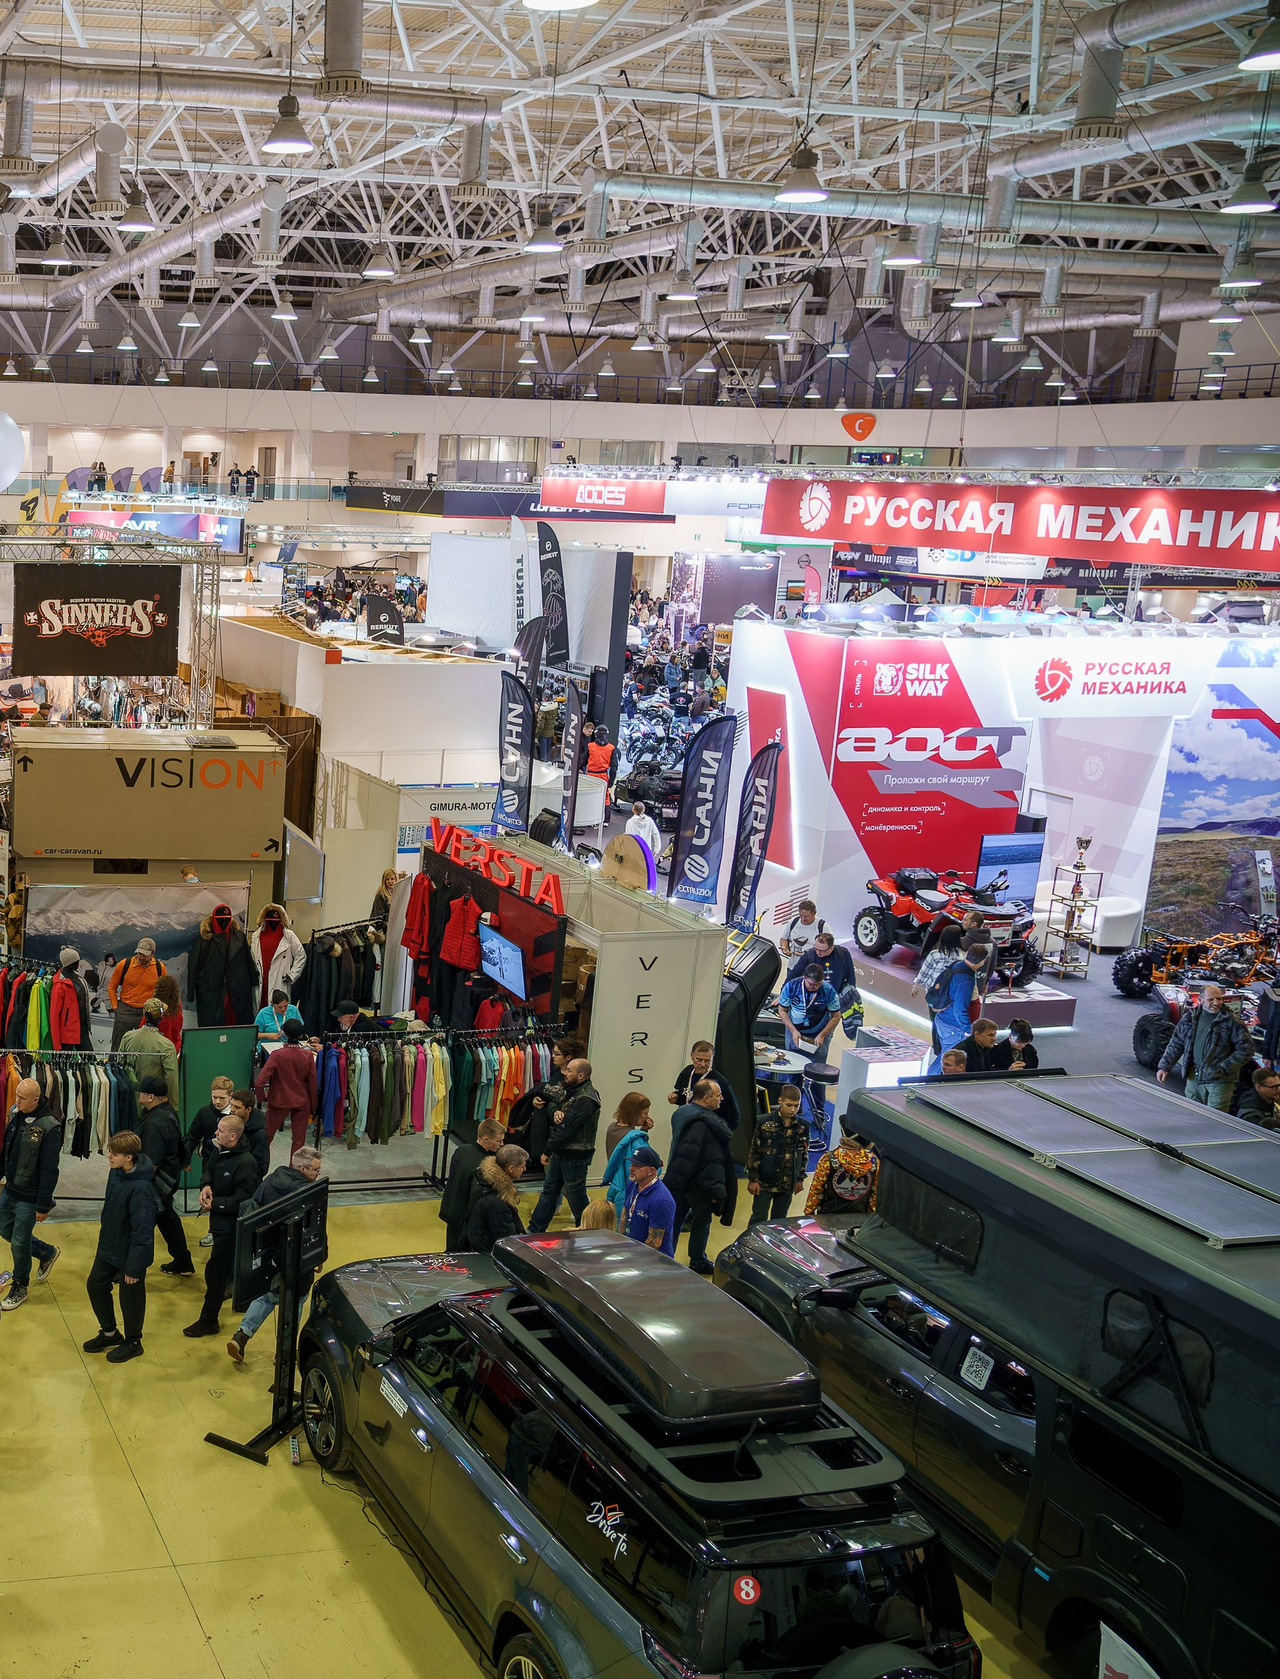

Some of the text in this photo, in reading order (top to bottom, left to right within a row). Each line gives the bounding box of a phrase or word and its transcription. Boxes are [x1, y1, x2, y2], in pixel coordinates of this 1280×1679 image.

[855, 419, 863, 433] C
[843, 494, 1016, 536] РУССКАЯ
[109, 519, 157, 532] LAVR
[210, 523, 228, 536] LAVR
[540, 551, 560, 561] BERKUT
[989, 560, 1037, 568] квадроциклов
[40, 599, 154, 635] SINNERS
[370, 624, 399, 632] BERKUT
[905, 662, 951, 680] SILK
[1084, 661, 1172, 676] РУССКАЯ
[905, 680, 950, 697] WAY
[1081, 679, 1188, 696] МЕХАНИКА
[114, 757, 264, 790] VISION
[883, 774, 991, 786] Проложи свой маршрут
[692, 750, 723, 846] САНИ
[867, 805, 903, 814] динамика
[910, 805, 942, 813] контроль
[864, 822, 919, 832] манёвренность
[43, 847, 103, 856] car-caravan.ru
[430, 816, 565, 916] VERSTA
[740, 1578, 755, 1601] 8
